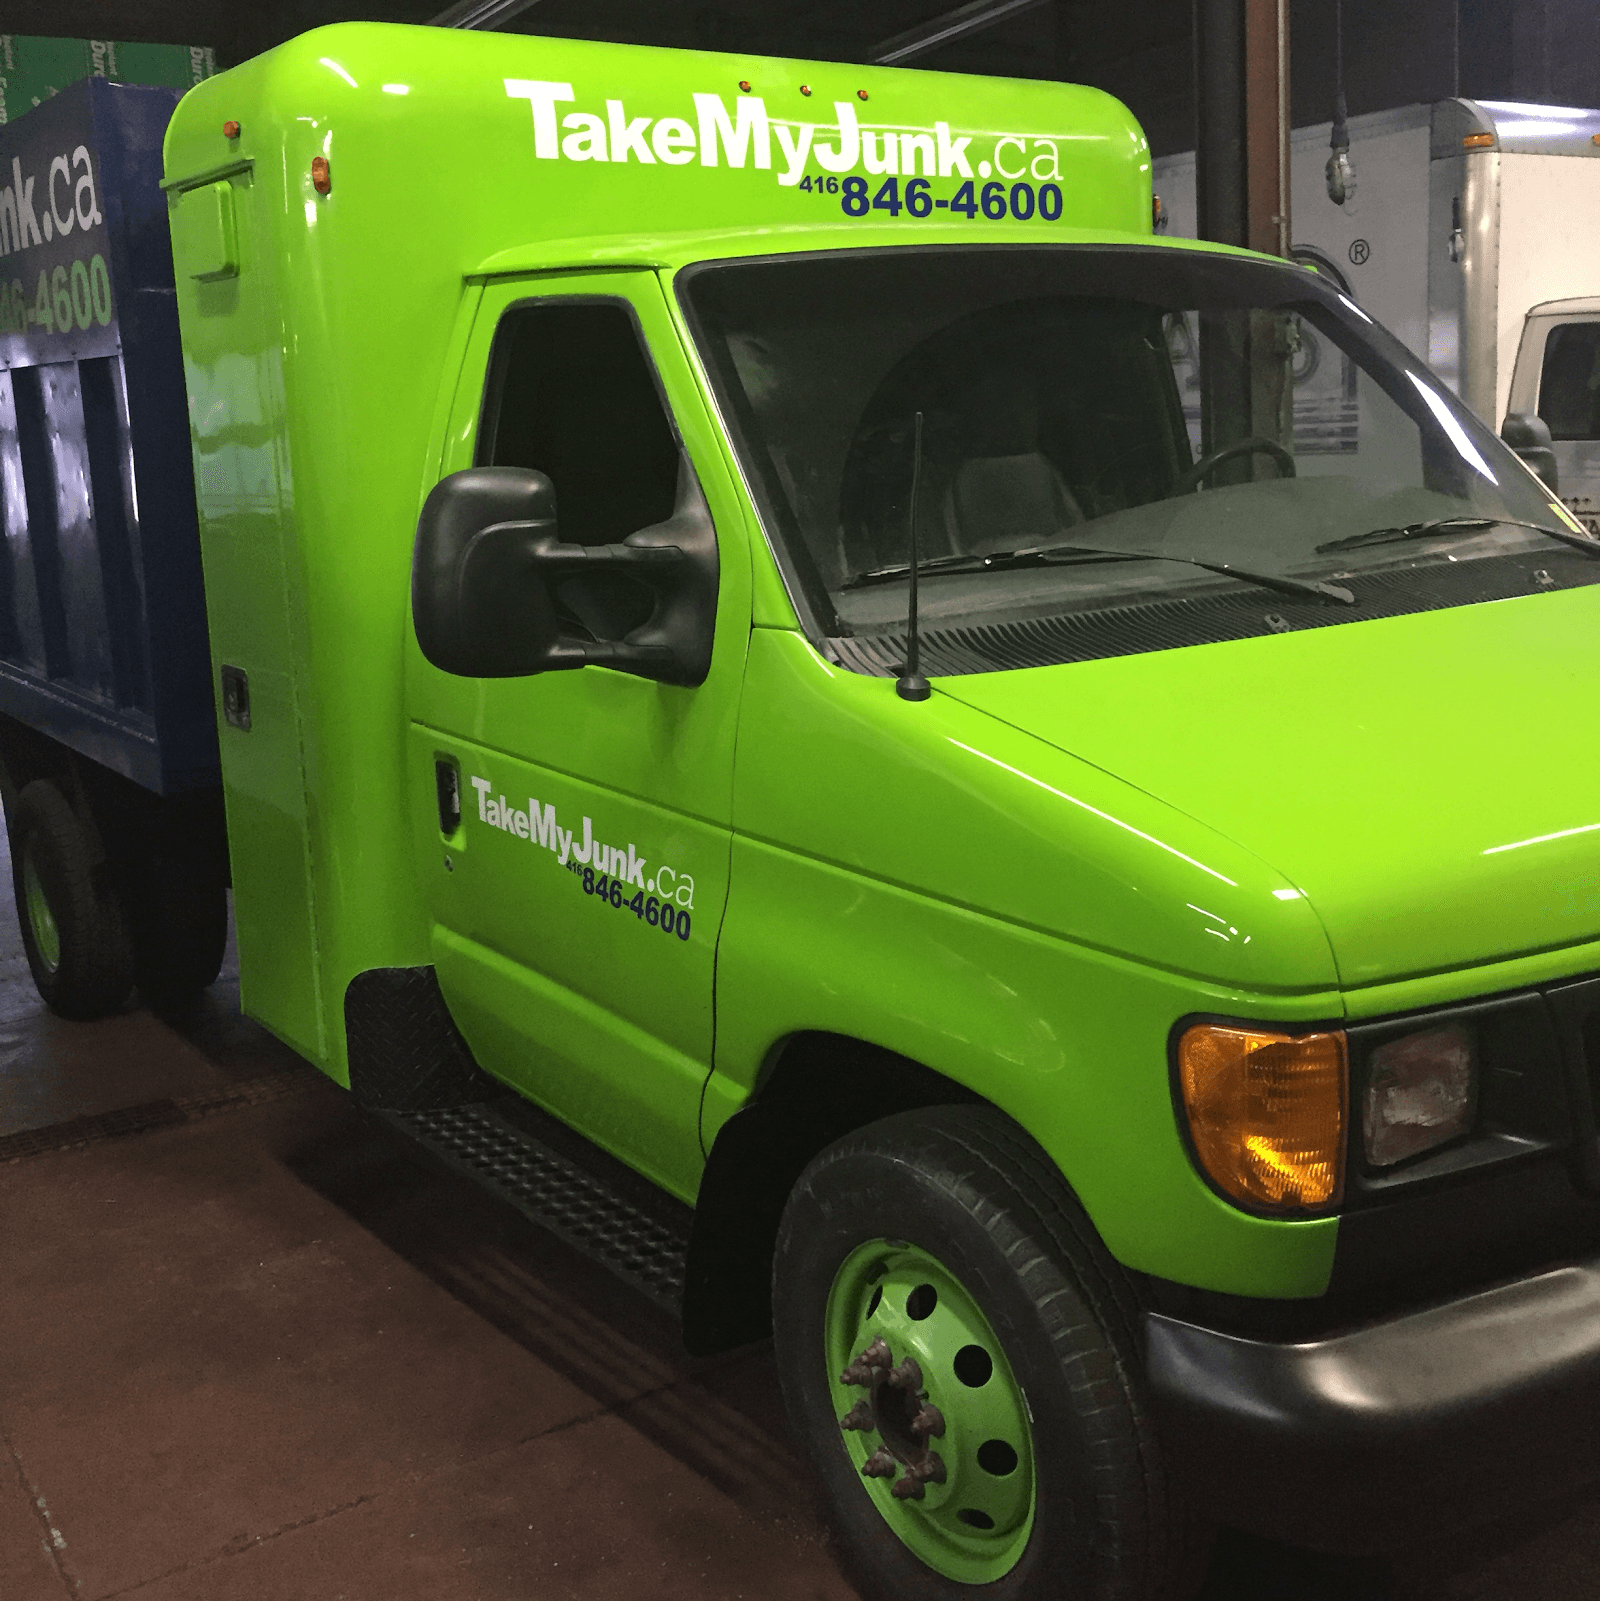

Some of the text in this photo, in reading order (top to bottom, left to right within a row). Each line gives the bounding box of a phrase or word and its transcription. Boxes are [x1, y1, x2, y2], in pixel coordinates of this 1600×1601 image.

[503, 78, 1063, 186] TakeMyJunk.ca
[0, 145, 102, 256] nk.ca
[799, 176, 1063, 221] 416 846-4600
[471, 775, 695, 910] TakeMyJunk.ca
[566, 860, 691, 941] 416 846-4600
